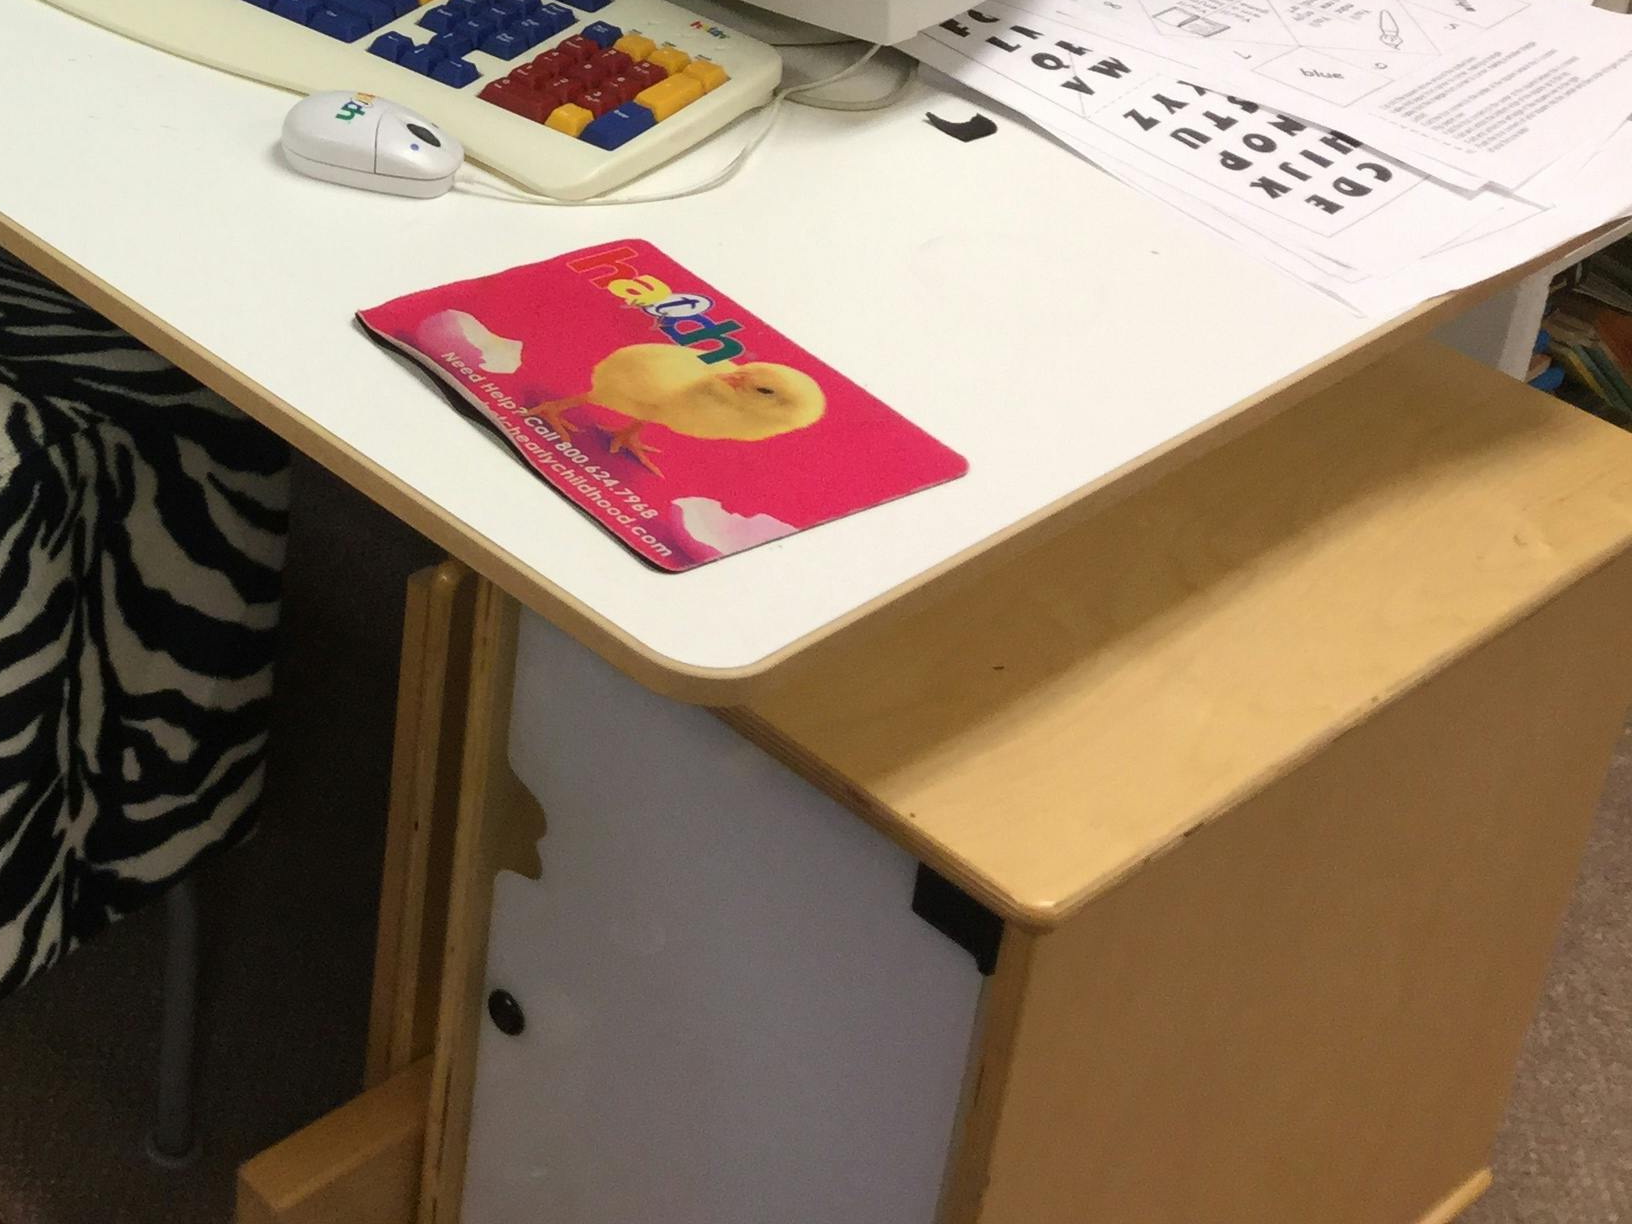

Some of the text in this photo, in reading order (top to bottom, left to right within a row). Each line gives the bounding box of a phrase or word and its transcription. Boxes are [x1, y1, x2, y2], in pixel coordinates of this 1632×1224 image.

[984, 36, 1023, 53] L
[1031, 52, 1070, 71] Q
[1060, 56, 1132, 96] V W
[1299, 67, 1345, 80] blue
[1151, 93, 1191, 115] Y
[1122, 108, 1162, 132] Z
[1202, 110, 1239, 132] T
[1169, 127, 1213, 150] U
[1241, 133, 1278, 154] O
[1218, 150, 1254, 171] P
[1278, 161, 1313, 182] J
[1249, 176, 1293, 200] K
[1304, 162, 1393, 215] C D E
[566, 247, 746, 365] hatch
[441, 351, 659, 520] Need Help? Call 800.624.7968
